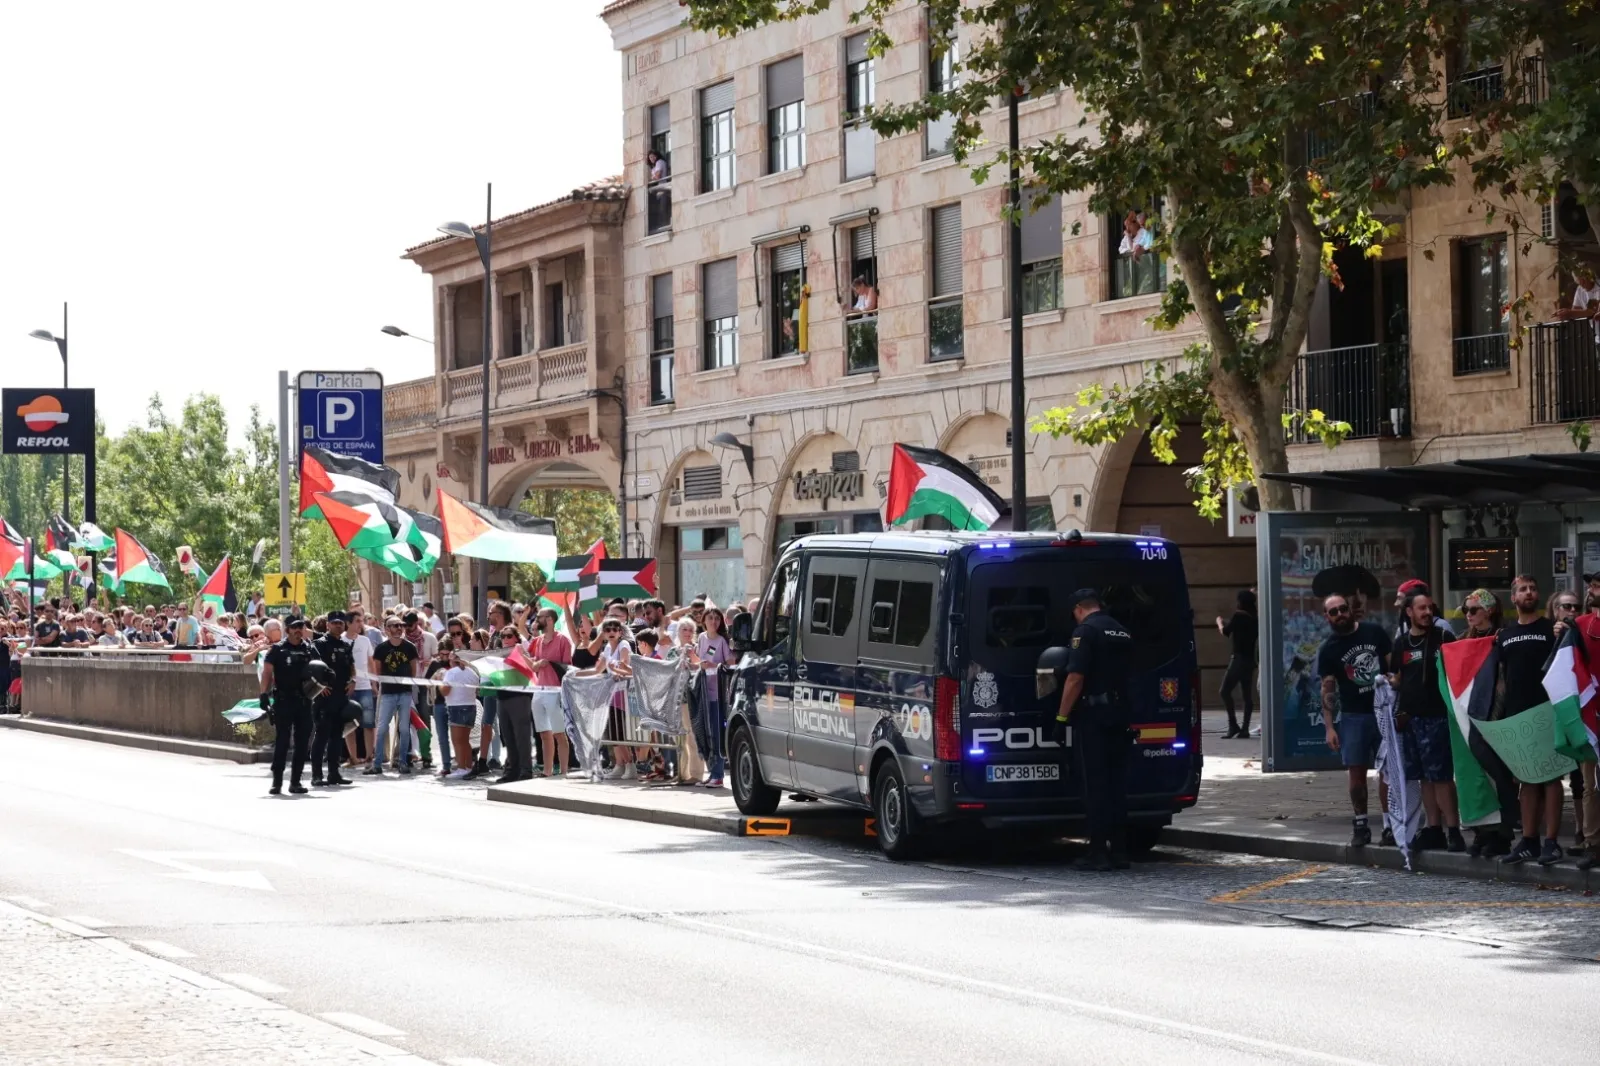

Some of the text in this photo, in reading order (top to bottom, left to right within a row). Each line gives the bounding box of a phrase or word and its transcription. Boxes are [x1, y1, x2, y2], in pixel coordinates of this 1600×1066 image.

[315, 373, 363, 388] Parkia
[325, 396, 355, 434] P
[16, 436, 70, 447] REPSOL
[345, 440, 376, 449] ESPAÑA
[1303, 544, 1393, 570] SALAMANCA
[794, 686, 841, 712] POLICIA
[794, 708, 856, 739] NACIONAL
[972, 727, 1072, 751] POLI
[1143, 748, 1177, 758] @policia
[994, 765, 1059, 780] CNP3815BC
